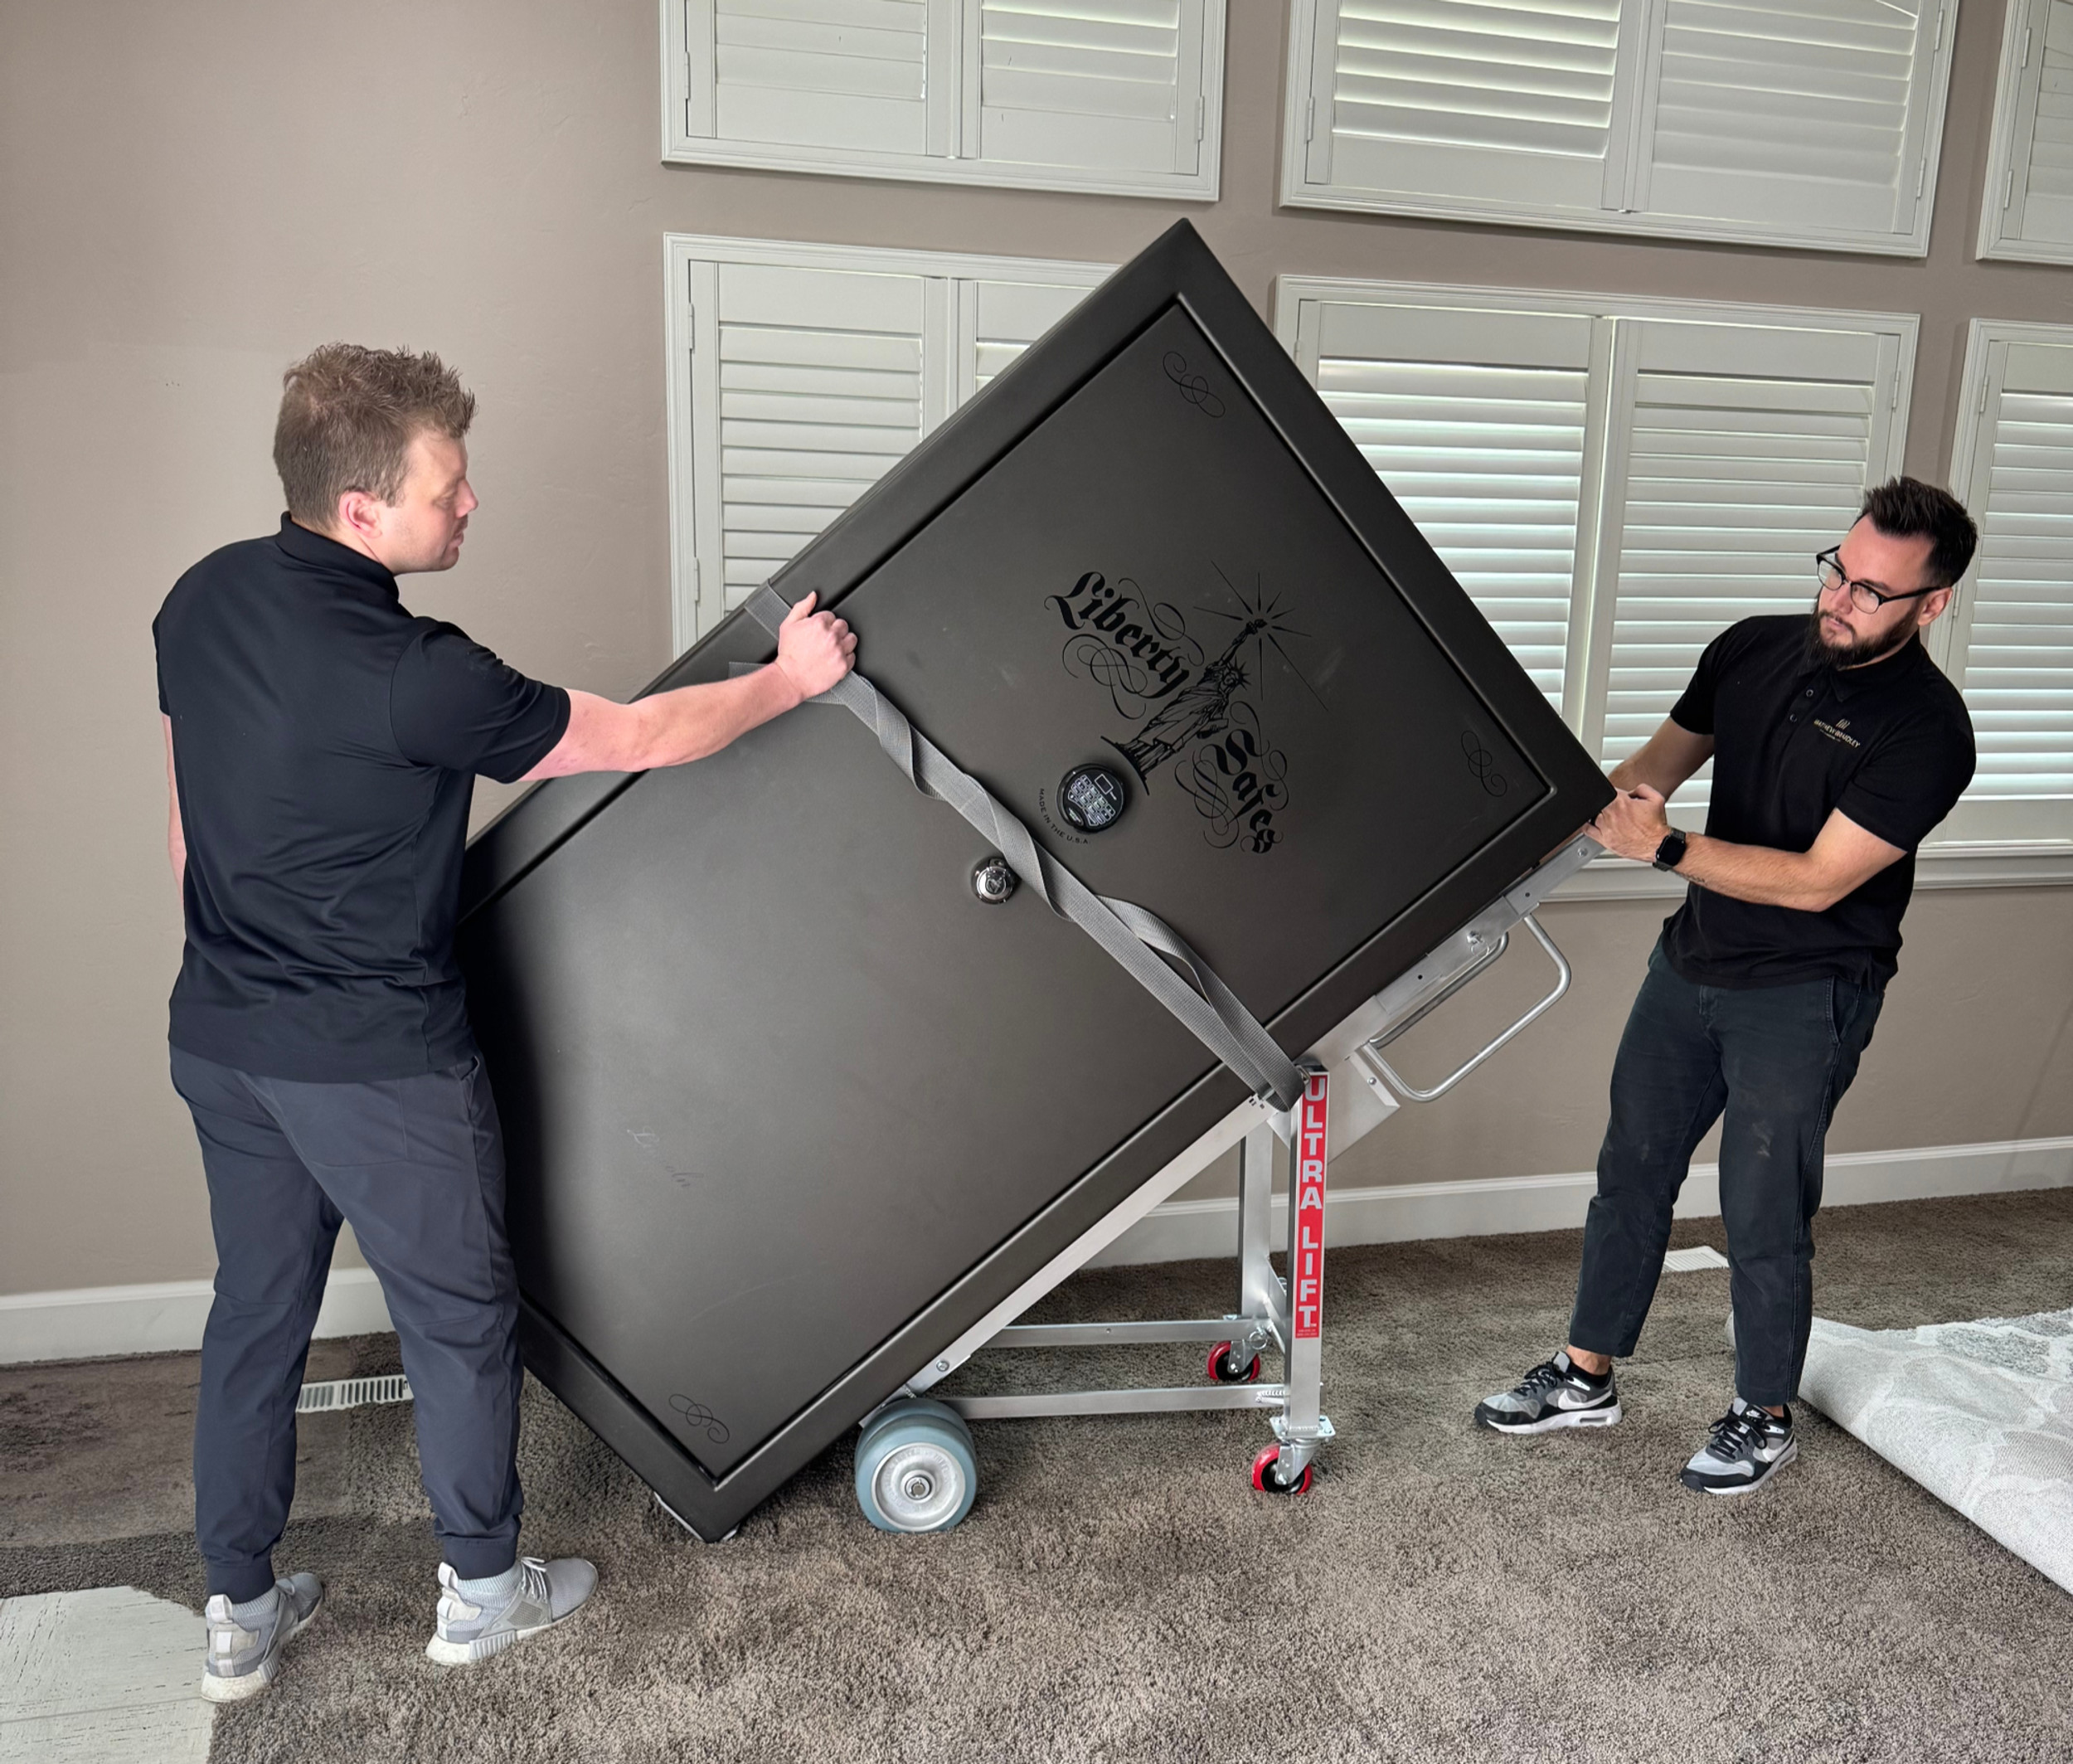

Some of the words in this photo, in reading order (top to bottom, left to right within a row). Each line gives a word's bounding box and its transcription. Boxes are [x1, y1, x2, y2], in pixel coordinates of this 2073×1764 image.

[1044, 571, 1191, 699] Liberty
[1038, 788, 1047, 814] MADE
[1043, 814, 1051, 824] IN
[1051, 824, 1066, 838] THE
[1200, 729, 1283, 854] Safes
[1299, 1076, 1326, 1210] ULTRA
[1299, 1226, 1318, 1328] LIFT
